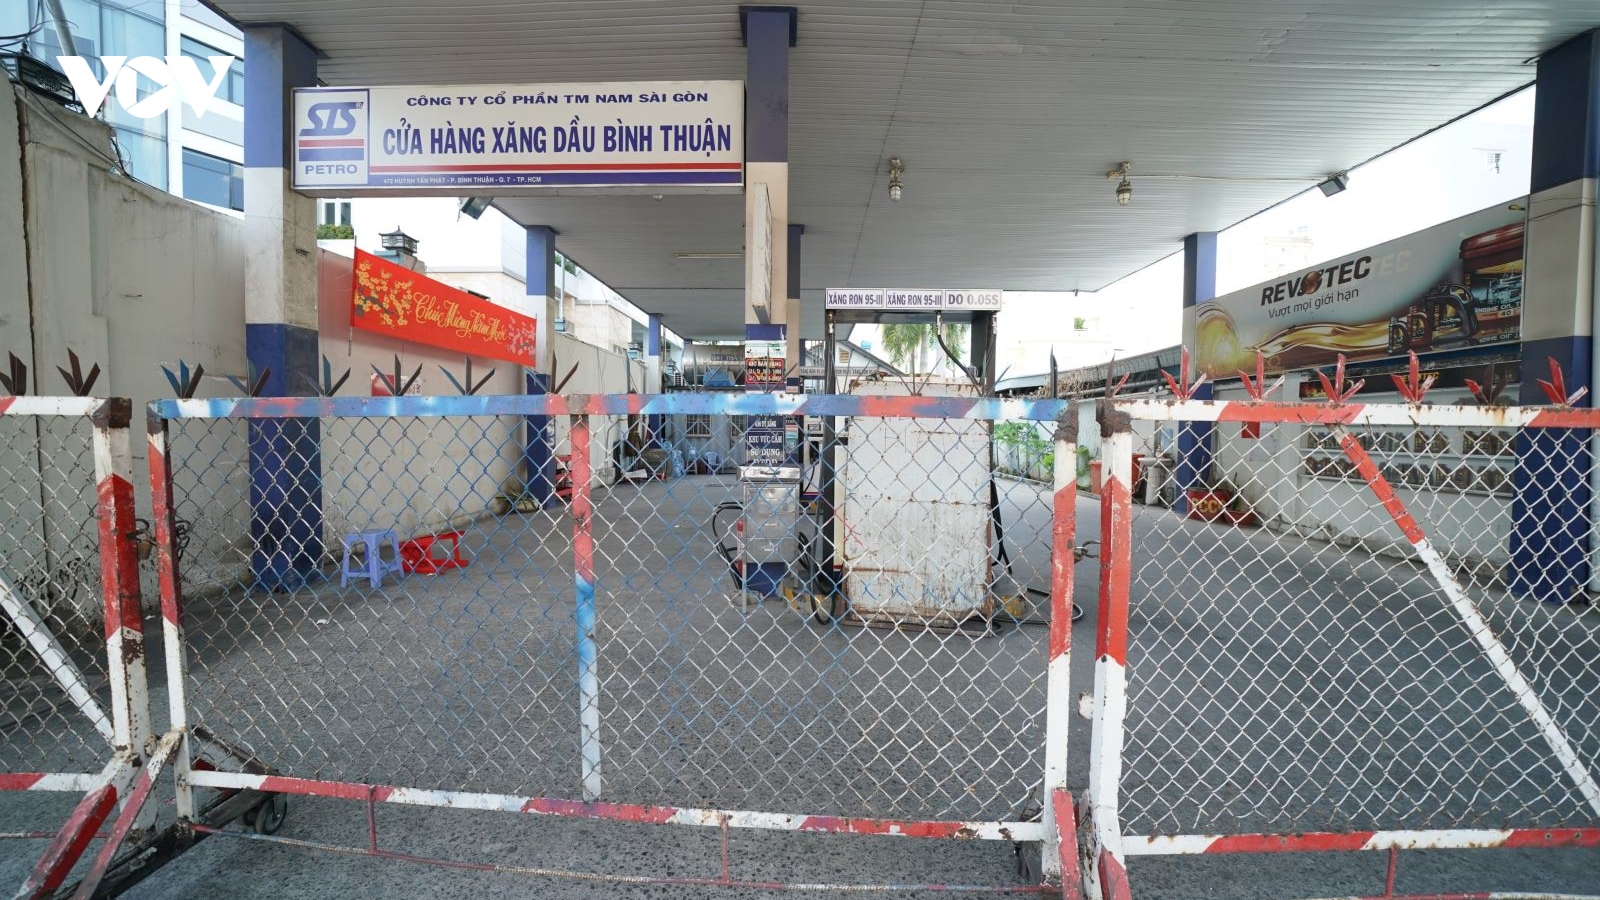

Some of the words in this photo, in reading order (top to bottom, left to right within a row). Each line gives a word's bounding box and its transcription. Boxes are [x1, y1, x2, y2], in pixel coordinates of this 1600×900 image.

[406, 94, 452, 107] CÔNG
[456, 96, 478, 106] TY
[483, 91, 506, 105] CỔ
[564, 94, 590, 104] TM
[595, 93, 633, 103] NAM
[639, 92, 667, 103] SÀI
[672, 91, 709, 102] GÒN
[383, 117, 423, 156] CỬA
[430, 120, 485, 154] HÀNG
[492, 120, 547, 153] XĂNG
[553, 115, 596, 153] DẦU
[603, 118, 653, 153] BÌNH
[660, 117, 731, 157] THUẬN
[305, 164, 358, 175] PETRO
[457, 175, 473, 183] BÌNH
[473, 175, 494, 183] THUẬN
[828, 292, 847, 305] XĂNG
[849, 293, 863, 305] RON
[865, 294, 883, 306] 95-III
[887, 292, 906, 306] XĂNG
[907, 294, 922, 306] RON
[923, 294, 942, 306] 95-III
[948, 293, 964, 305] DO
[967, 293, 999, 305] 0.05S
[1268, 307, 1291, 319] Vượt
[1293, 300, 1312, 313] mọi
[1314, 292, 1334, 310] giới
[1337, 288, 1359, 303] hạn
[748, 435, 759, 443] KHU
[761, 447, 781, 457] DỤNG
